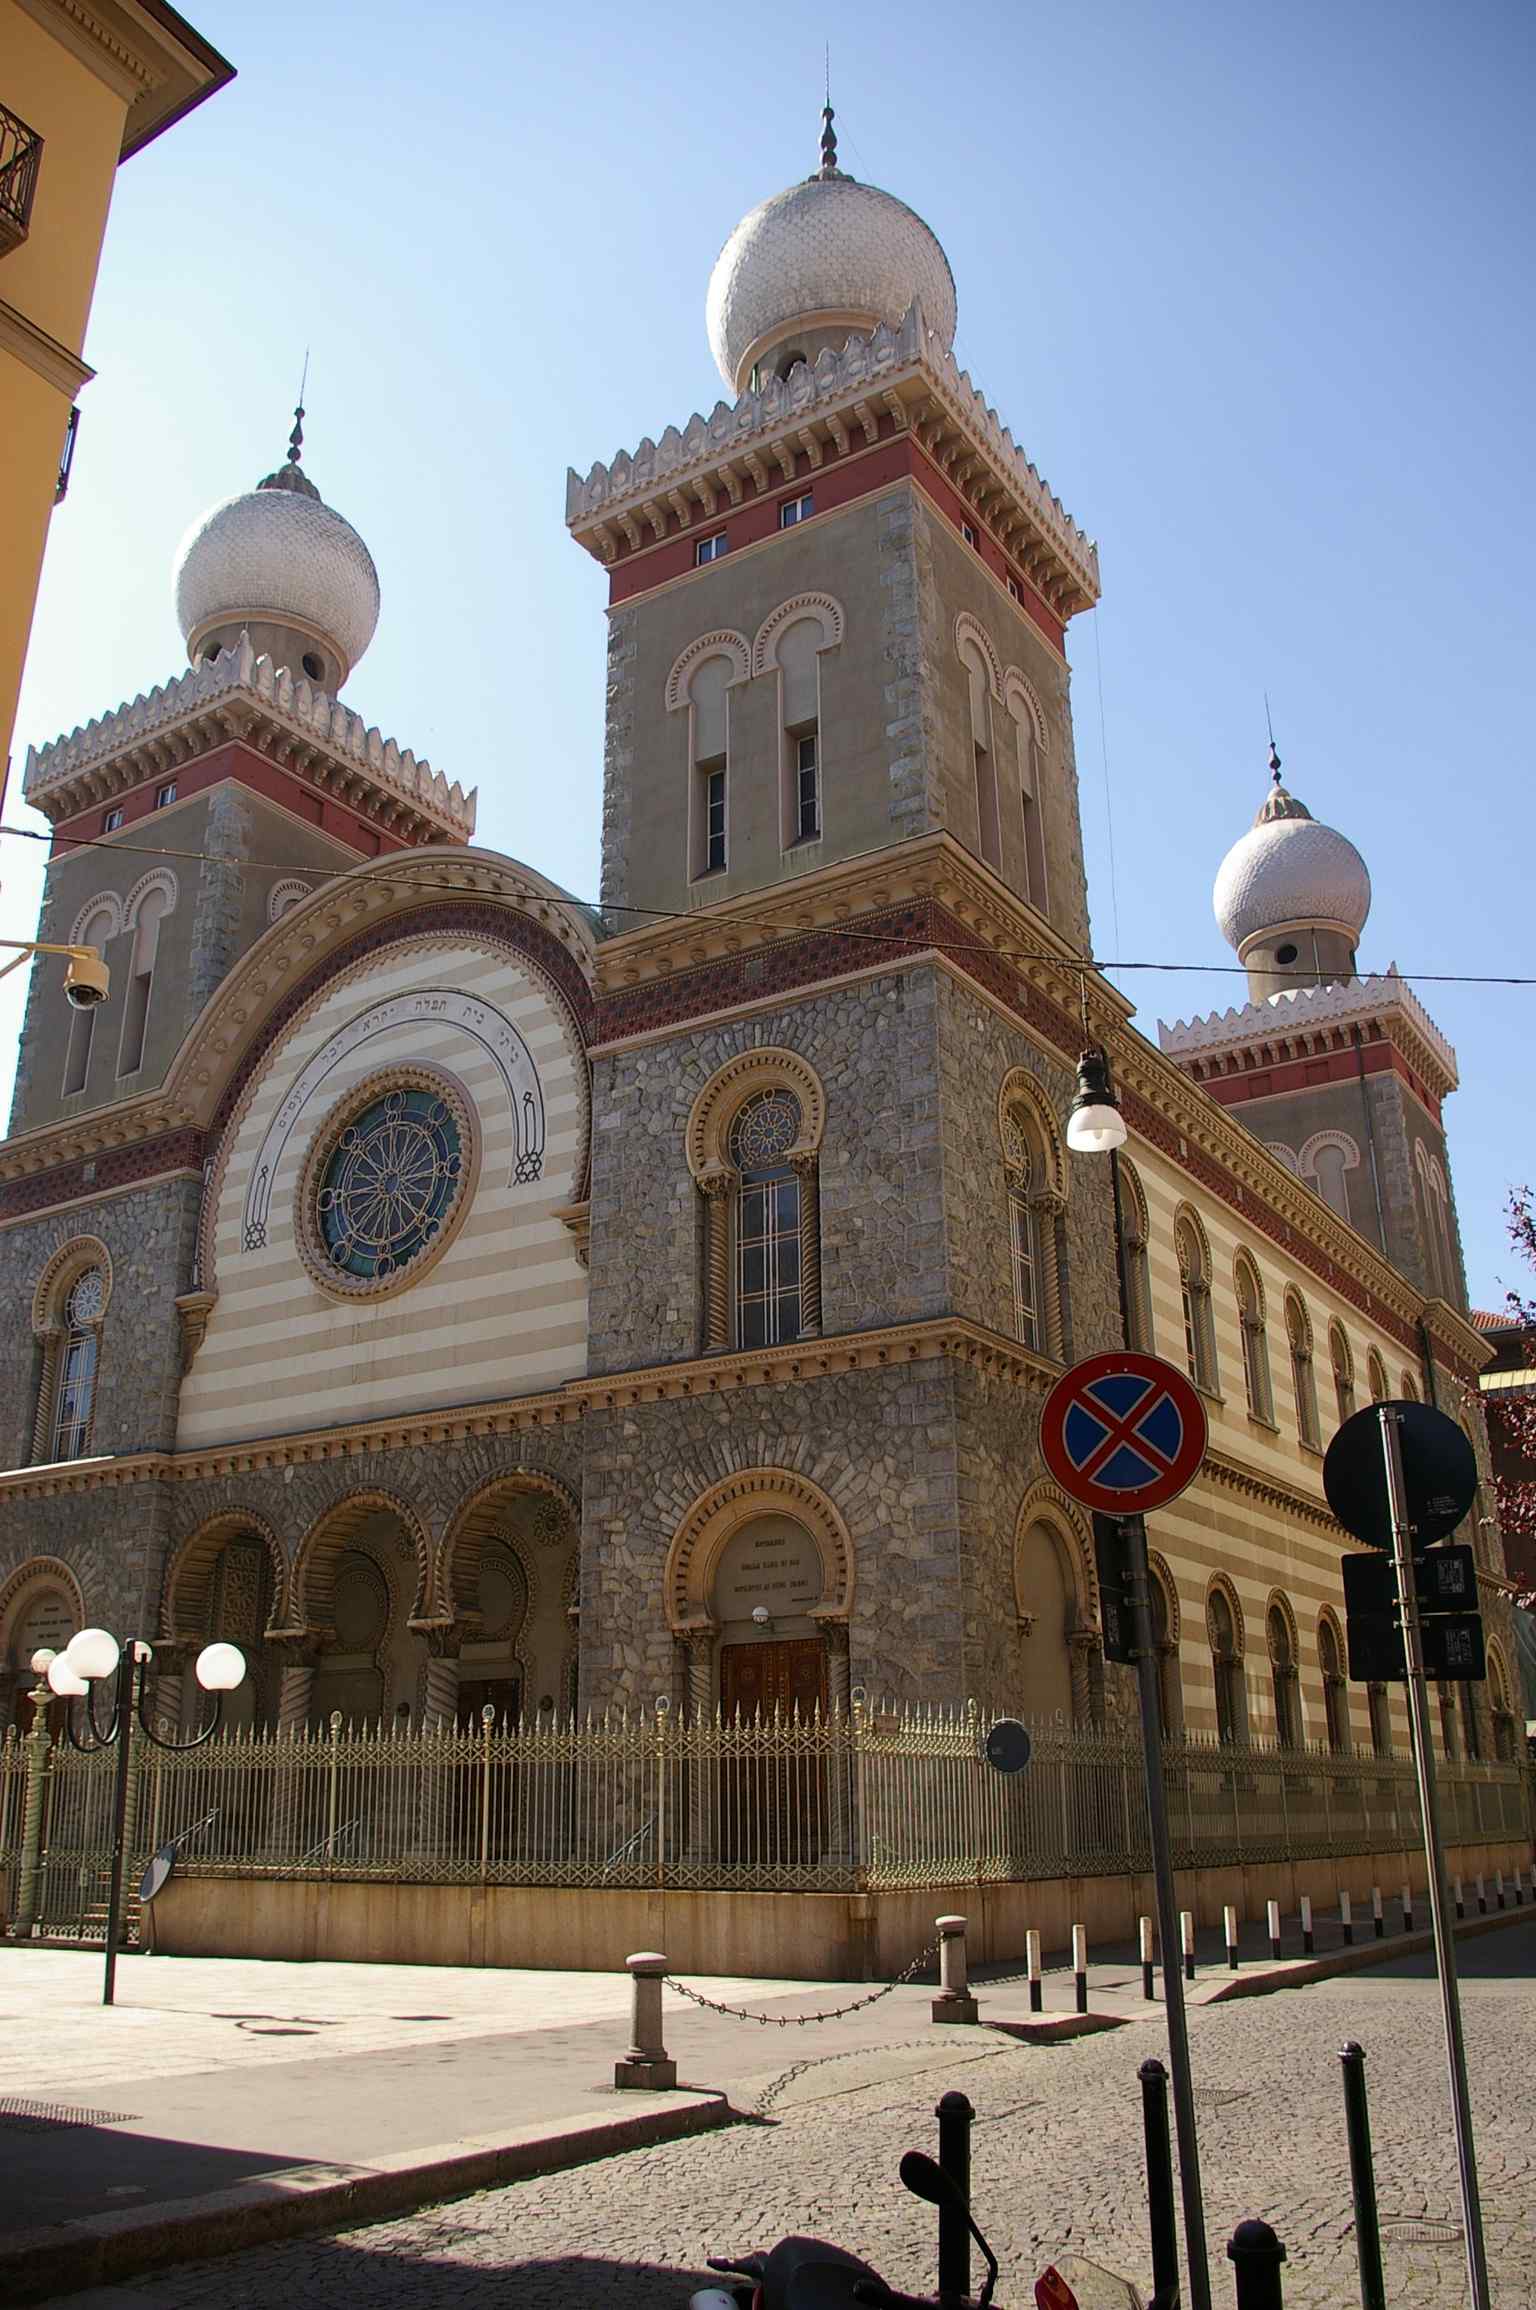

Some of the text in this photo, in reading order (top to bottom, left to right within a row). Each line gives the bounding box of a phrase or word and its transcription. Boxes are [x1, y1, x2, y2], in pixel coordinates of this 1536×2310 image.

[415, 998, 447, 1011] תפלה
[462, 1005, 485, 1025] בית
[362, 1008, 395, 1032] יקרא
[499, 1031, 520, 1064] ביתי
